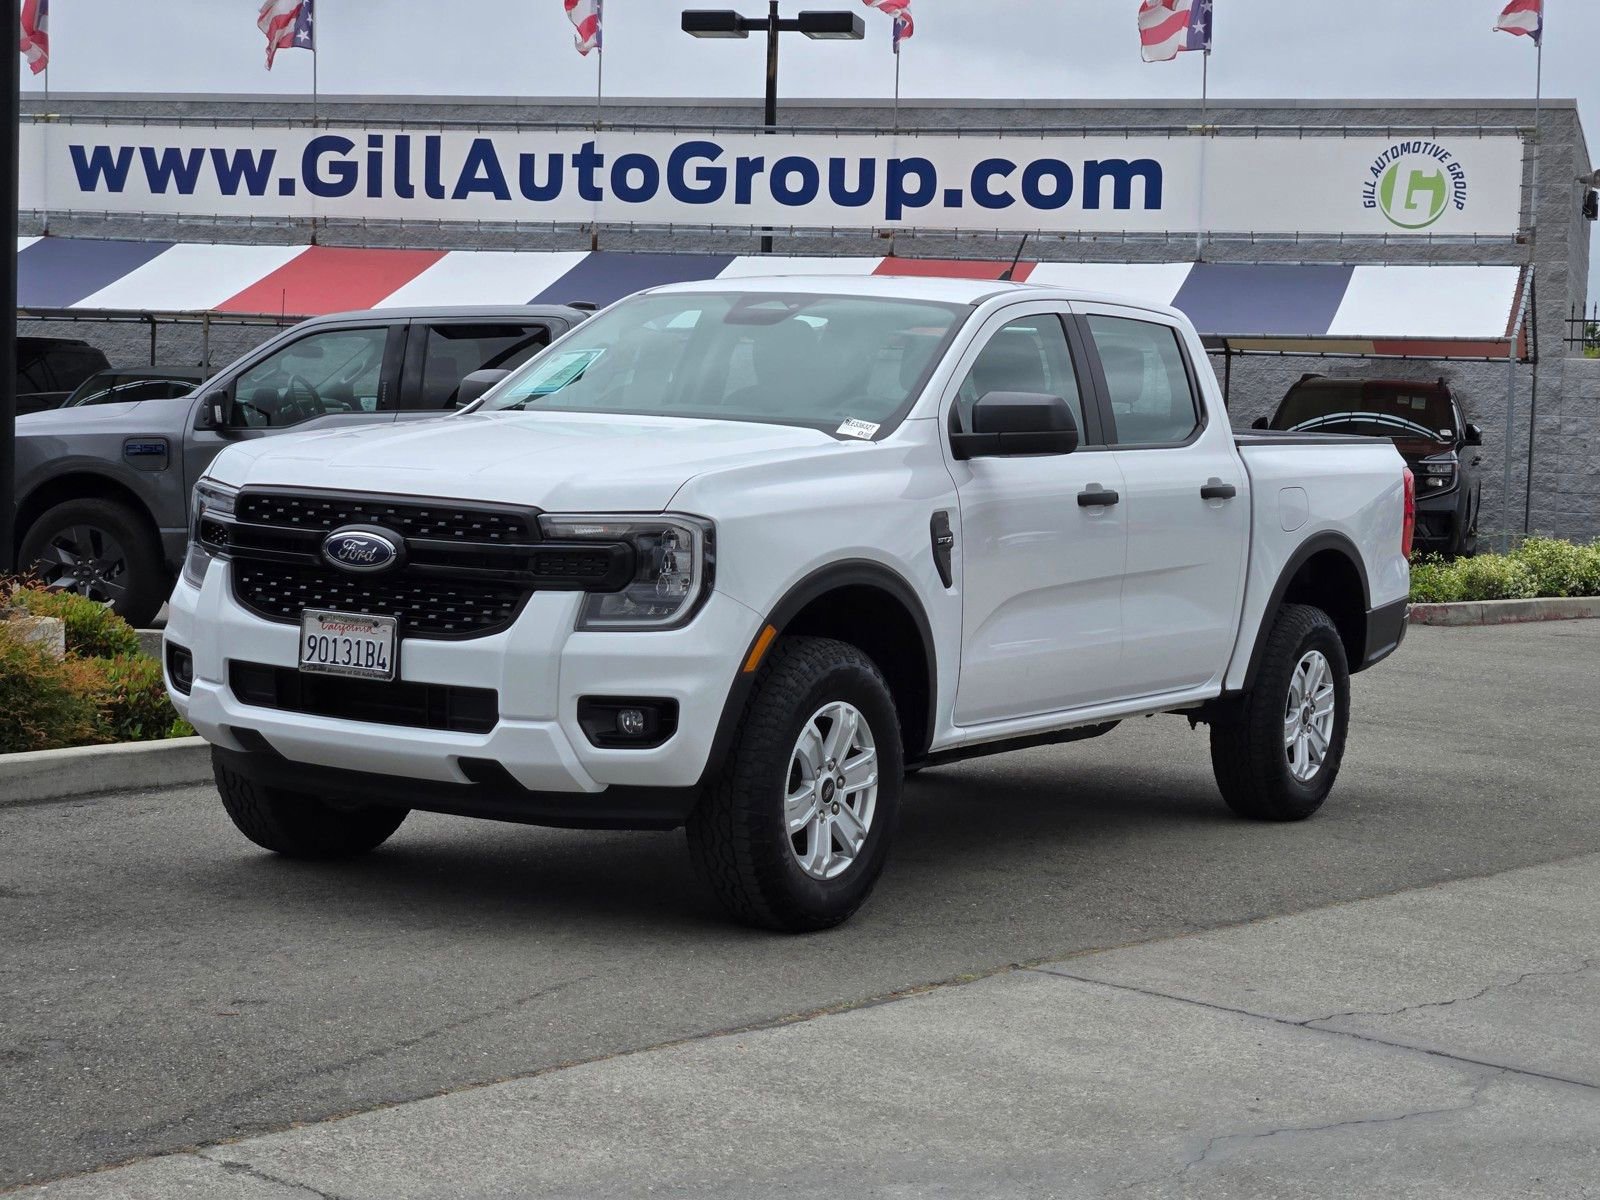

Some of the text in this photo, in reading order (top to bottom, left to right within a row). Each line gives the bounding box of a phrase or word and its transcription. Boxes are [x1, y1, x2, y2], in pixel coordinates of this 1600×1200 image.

[69, 134, 1163, 221] www.GillAutoGroup.com
[1362, 141, 1467, 211] GILL AUTOMOTIVE GROUP
[338, 538, 378, 562] Ford
[321, 622, 377, 635] California
[306, 634, 387, 670] 90131B4
